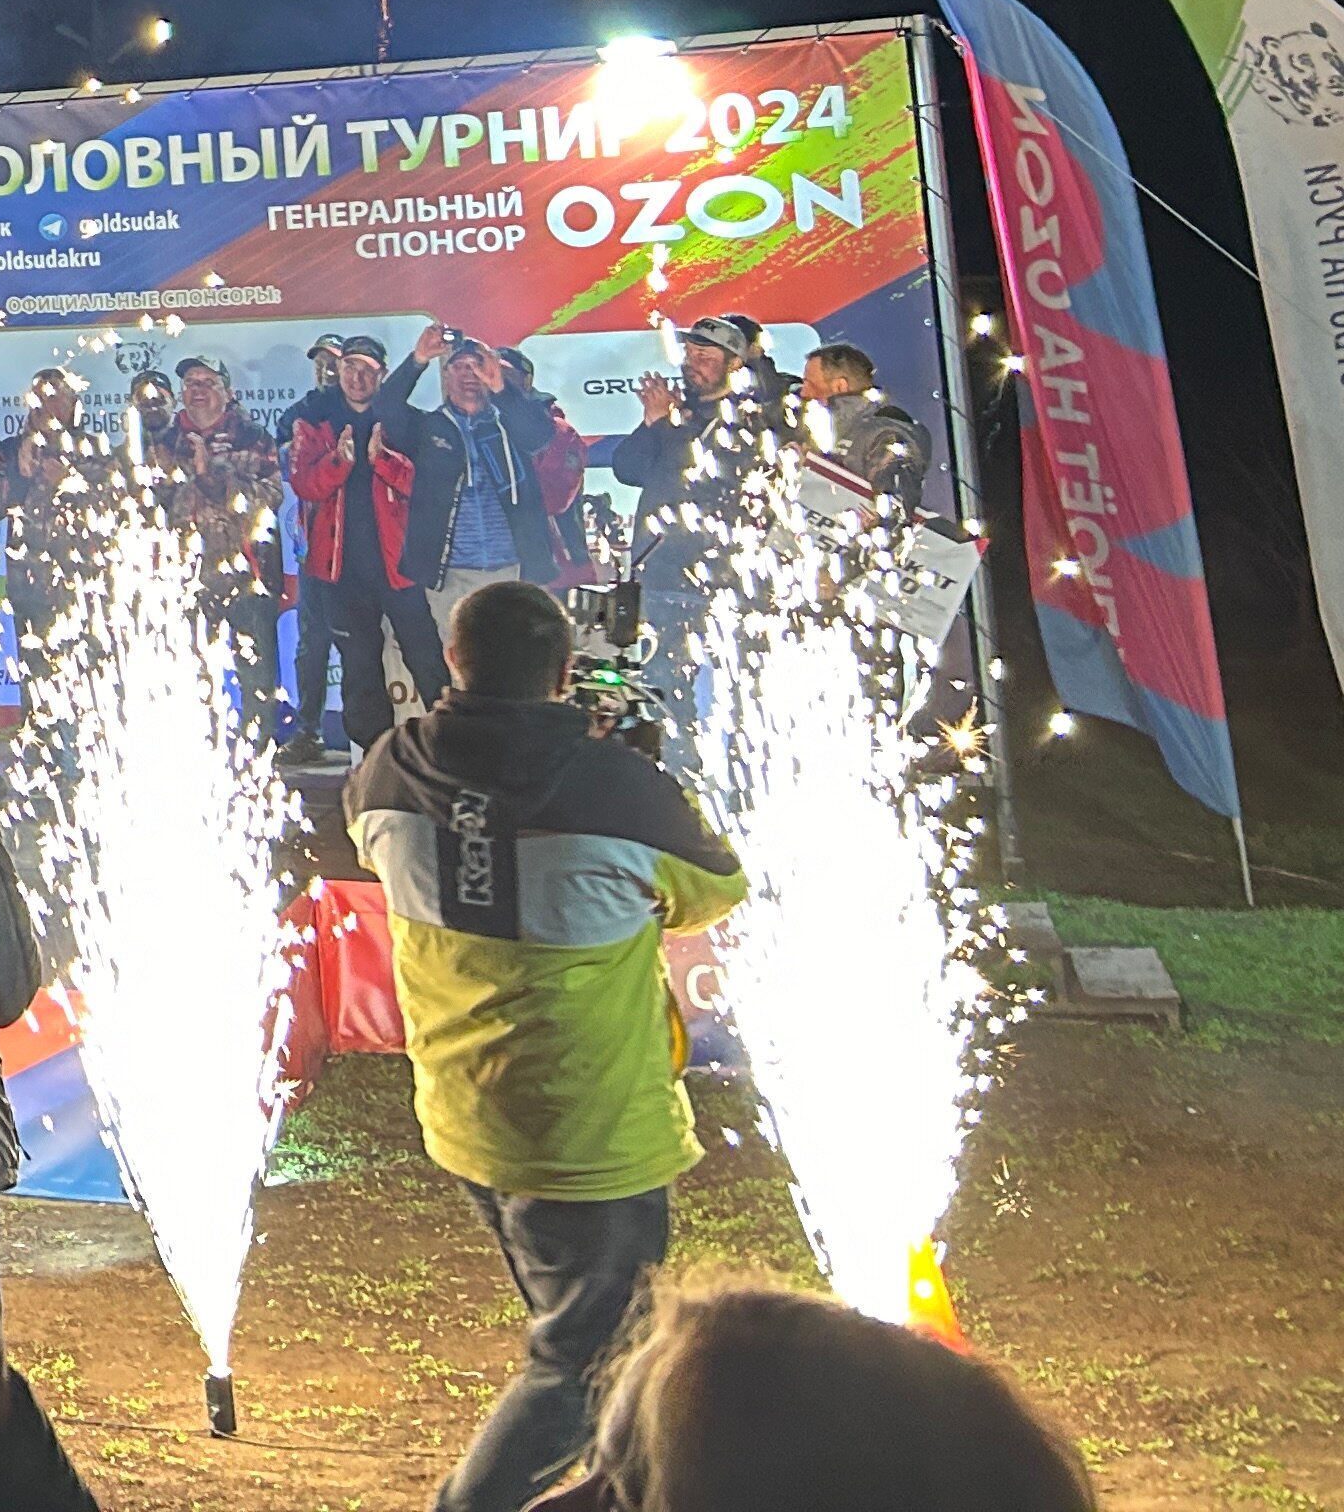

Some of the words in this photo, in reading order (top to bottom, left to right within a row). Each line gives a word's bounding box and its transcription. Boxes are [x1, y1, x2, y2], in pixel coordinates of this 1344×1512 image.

[664, 85, 852, 154] 2024
[79, 210, 180, 238] goldsudak
[267, 186, 525, 231] ГЕНЕРАЛЬНЫЙ
[545, 169, 864, 248] OZON
[355, 226, 526, 259] СПОНСОР
[6, 291, 160, 315] ОФИЦИАЛЬНЫЕ
[166, 286, 282, 308] СПОНСОРЫ:
